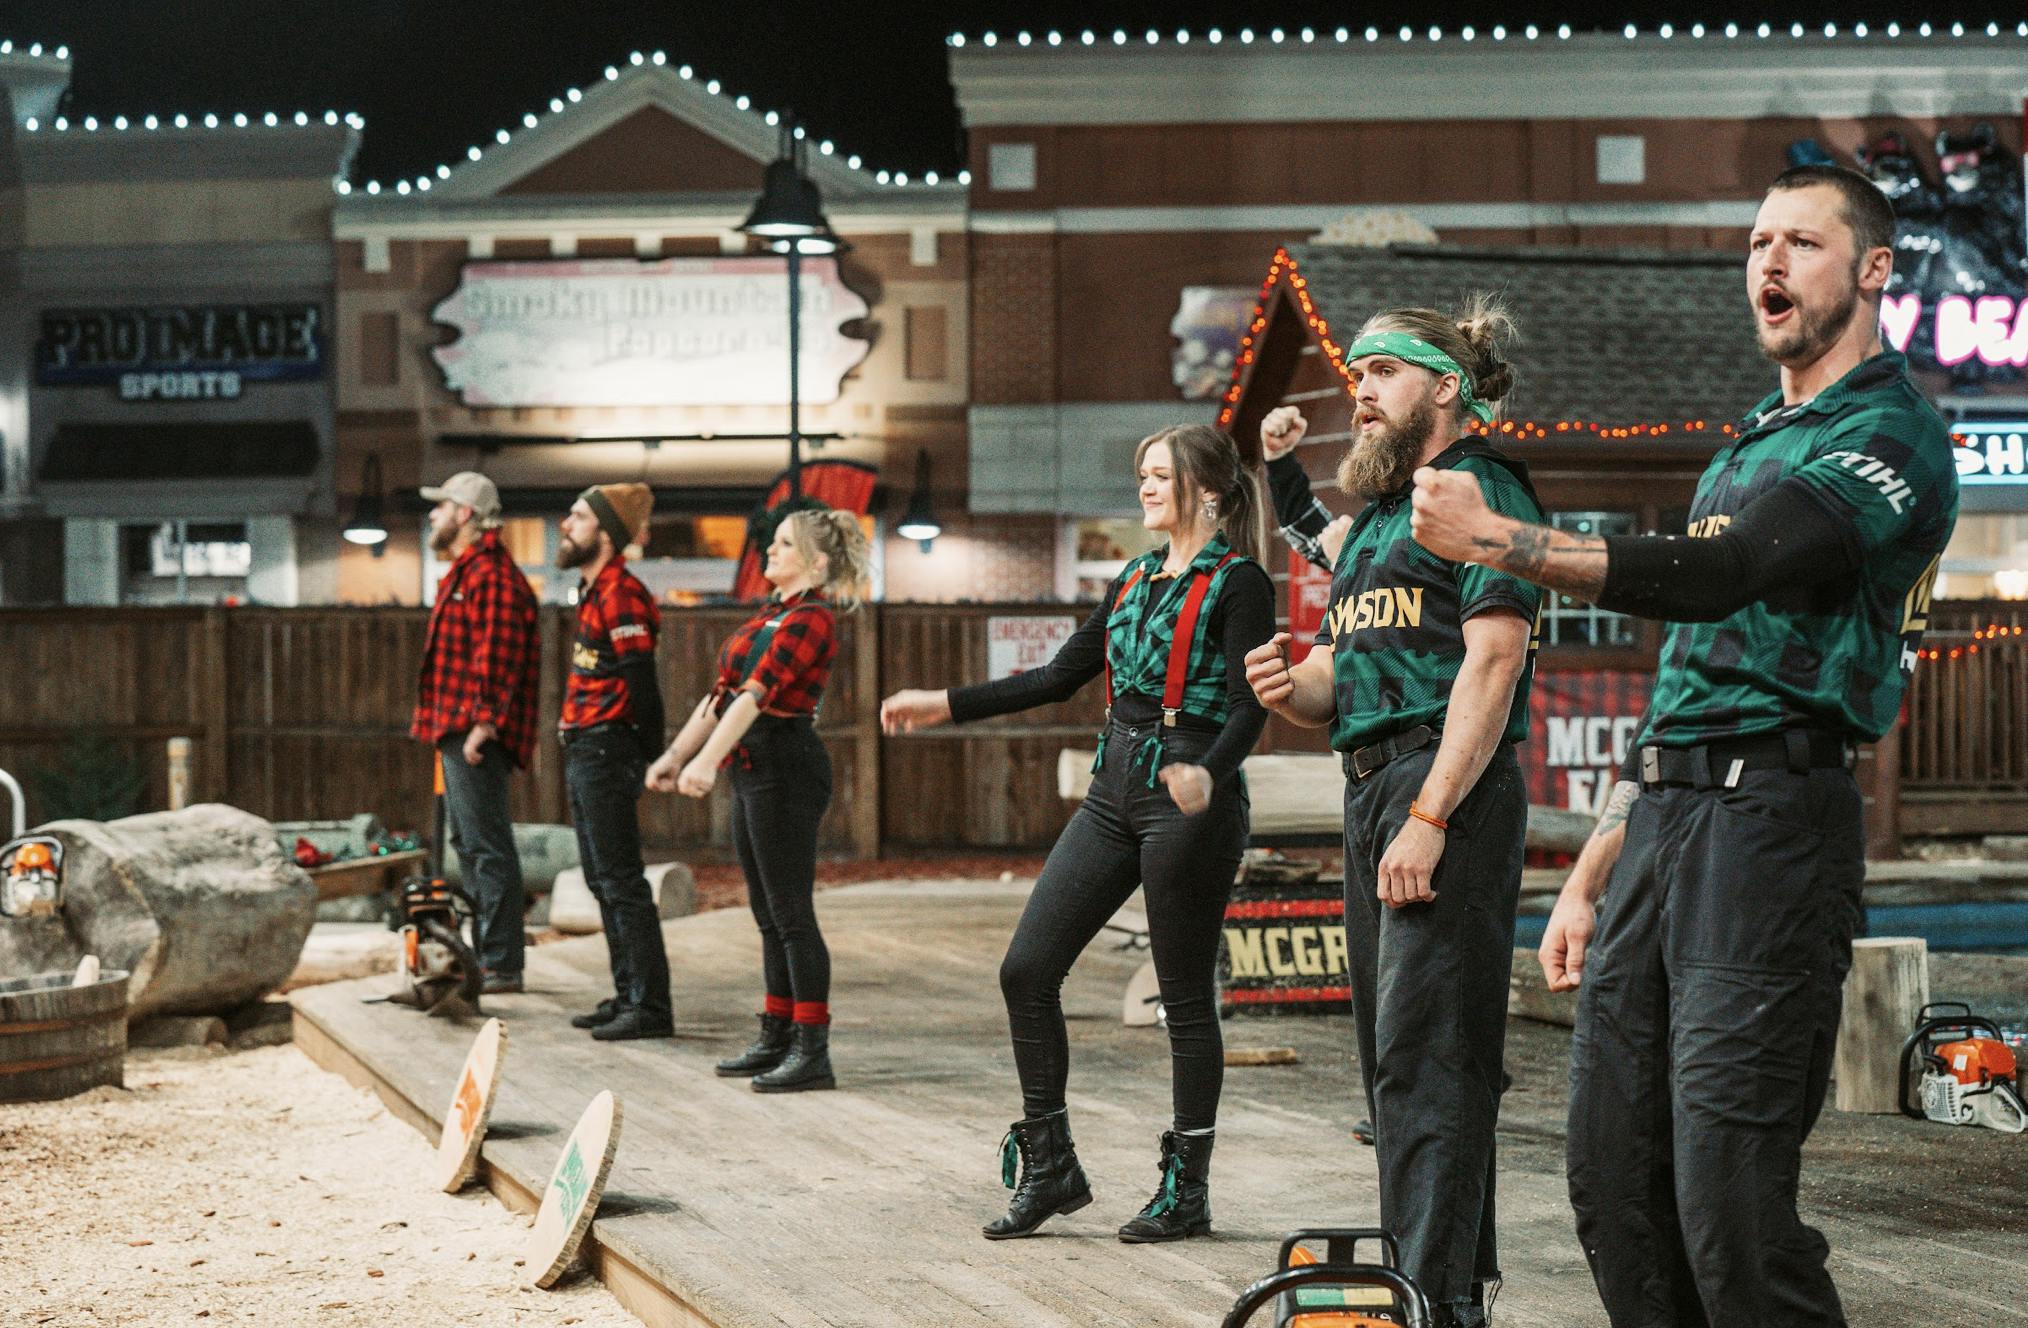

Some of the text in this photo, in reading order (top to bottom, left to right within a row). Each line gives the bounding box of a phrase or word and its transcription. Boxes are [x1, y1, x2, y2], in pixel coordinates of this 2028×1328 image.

[620, 280, 834, 316] Mountan
[44, 306, 320, 367] PRO IMAGE
[120, 371, 242, 399] SPORTS
[1952, 433, 2028, 475] SH
